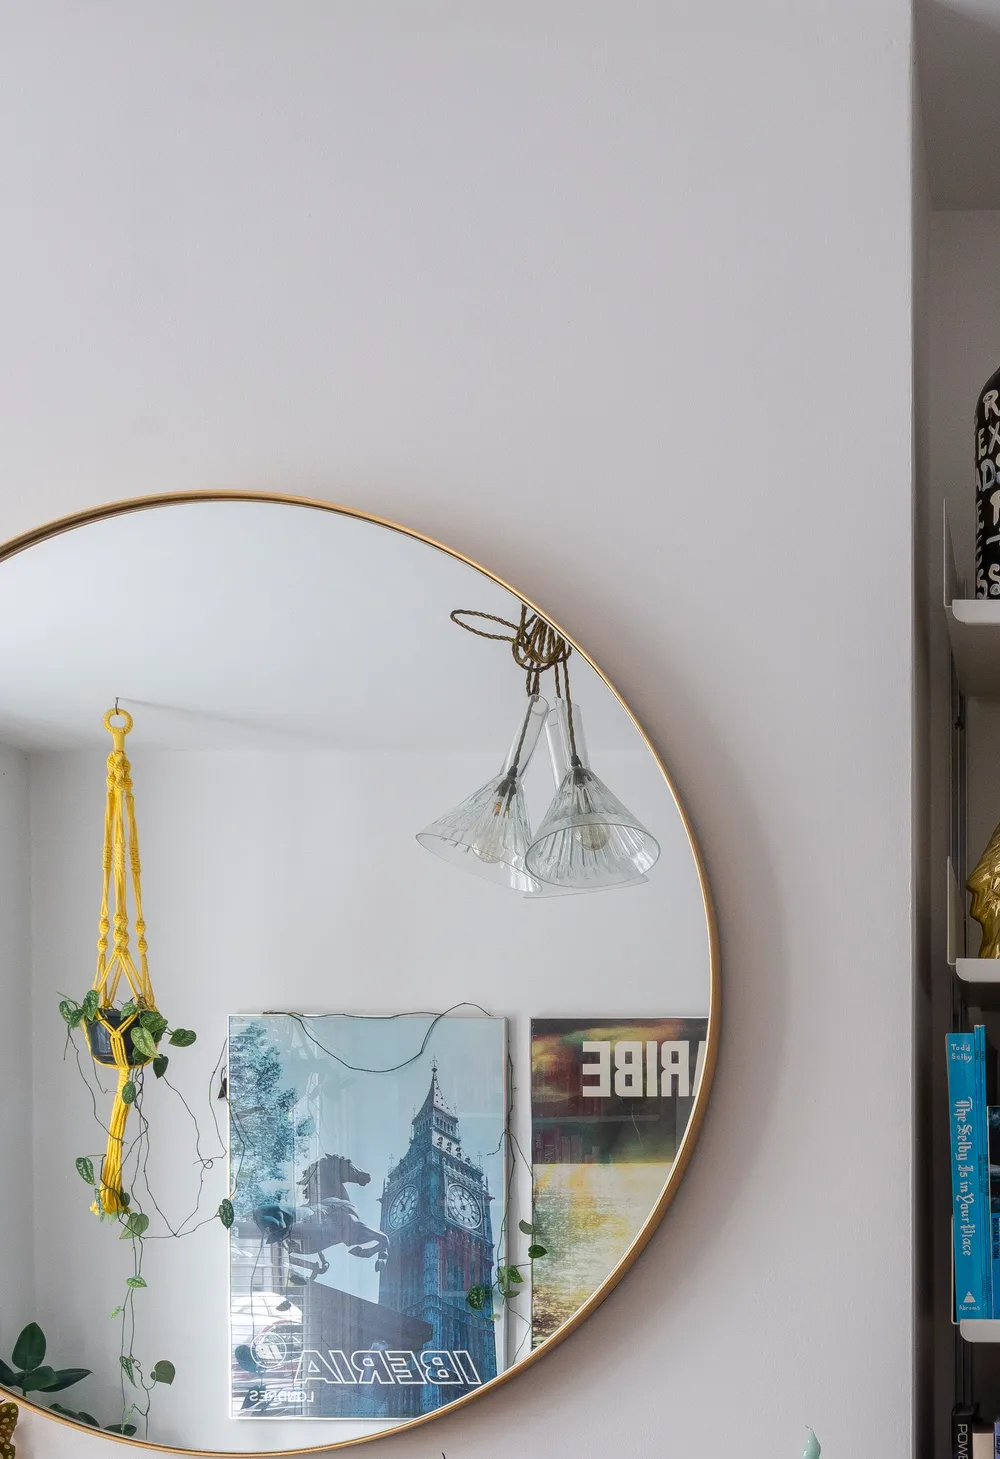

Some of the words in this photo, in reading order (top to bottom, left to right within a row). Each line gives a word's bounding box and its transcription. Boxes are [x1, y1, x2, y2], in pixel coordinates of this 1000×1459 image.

[954, 1096, 973, 1122] The
[955, 1124, 974, 1160] Selby
[957, 1164, 974, 1179] Is
[958, 1180, 973, 1193] in
[955, 1193, 974, 1224] Your
[961, 1224, 976, 1256] Place
